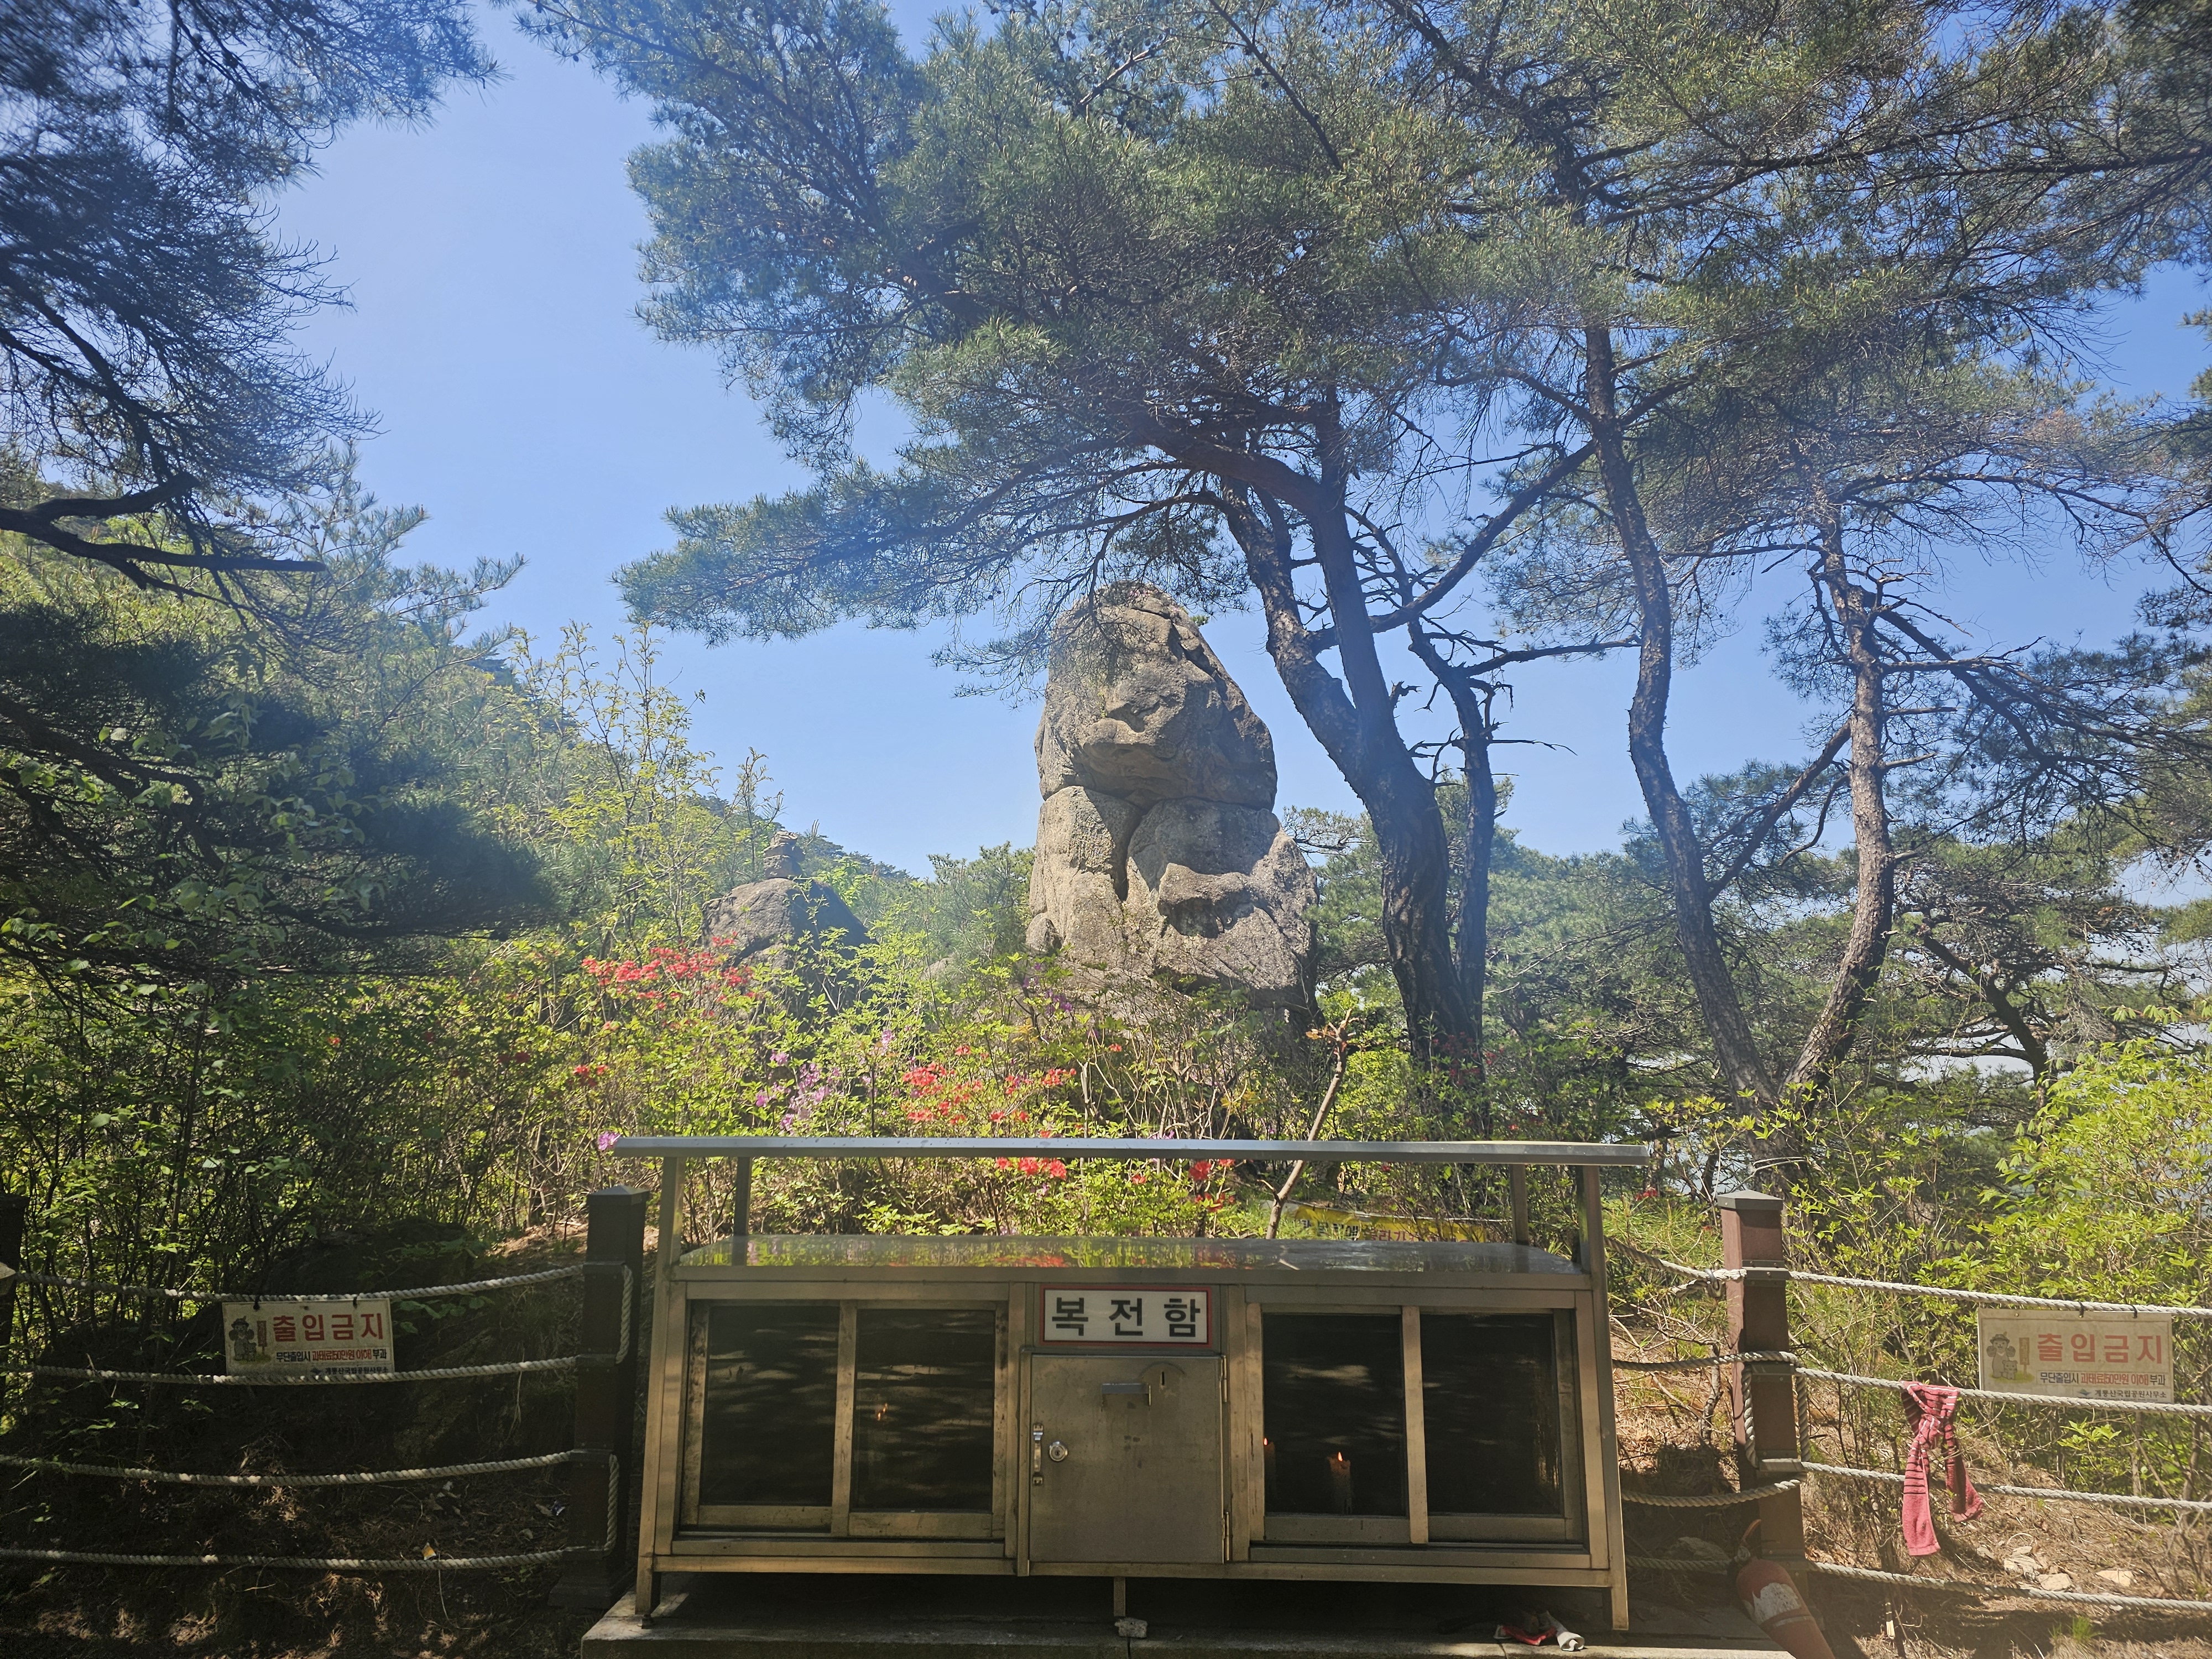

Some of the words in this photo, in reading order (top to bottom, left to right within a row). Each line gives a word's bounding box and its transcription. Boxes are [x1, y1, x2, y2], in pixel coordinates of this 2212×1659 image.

[273, 1312, 383, 1342] 출입금지
[1051, 1297, 1201, 1338] 복전함
[276, 1350, 311, 1362] 무단출입시
[373, 1348, 387, 1360] 부과
[2037, 1333, 2162, 1364] 출입금지
[2040, 1372, 2079, 1384] 무단출입시
[2150, 1374, 2166, 1386] 부과
[2094, 1389, 2167, 1398] 계룡산국립공원사무소
